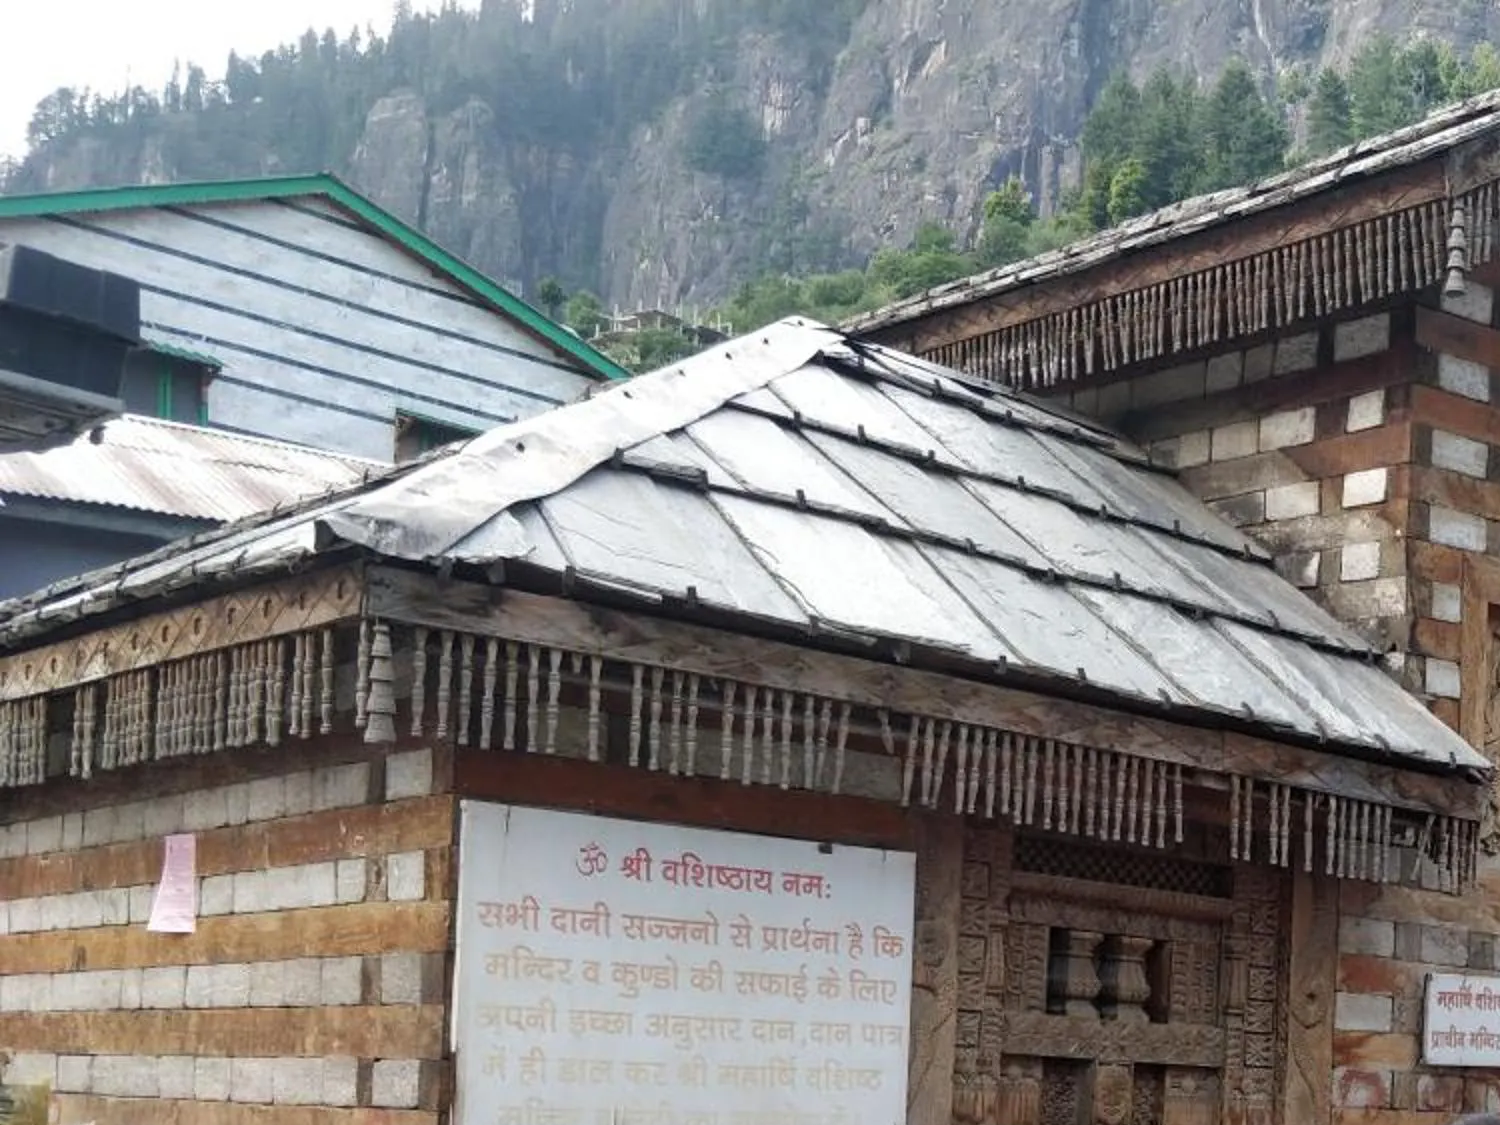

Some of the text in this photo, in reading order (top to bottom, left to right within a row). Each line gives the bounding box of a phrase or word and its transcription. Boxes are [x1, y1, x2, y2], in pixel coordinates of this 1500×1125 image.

[620, 848, 652, 882] श्री
[477, 896, 540, 932] सभी
[550, 902, 611, 939] दानी
[729, 914, 752, 949] से
[762, 918, 841, 956] प्रार्थना
[847, 922, 866, 961] है
[873, 926, 904, 959] कि
[483, 945, 573, 984] मन्दिर
[582, 959, 600, 984] व
[690, 960, 724, 994] की
[817, 967, 842, 1001] के
[849, 969, 898, 1006] लिए
